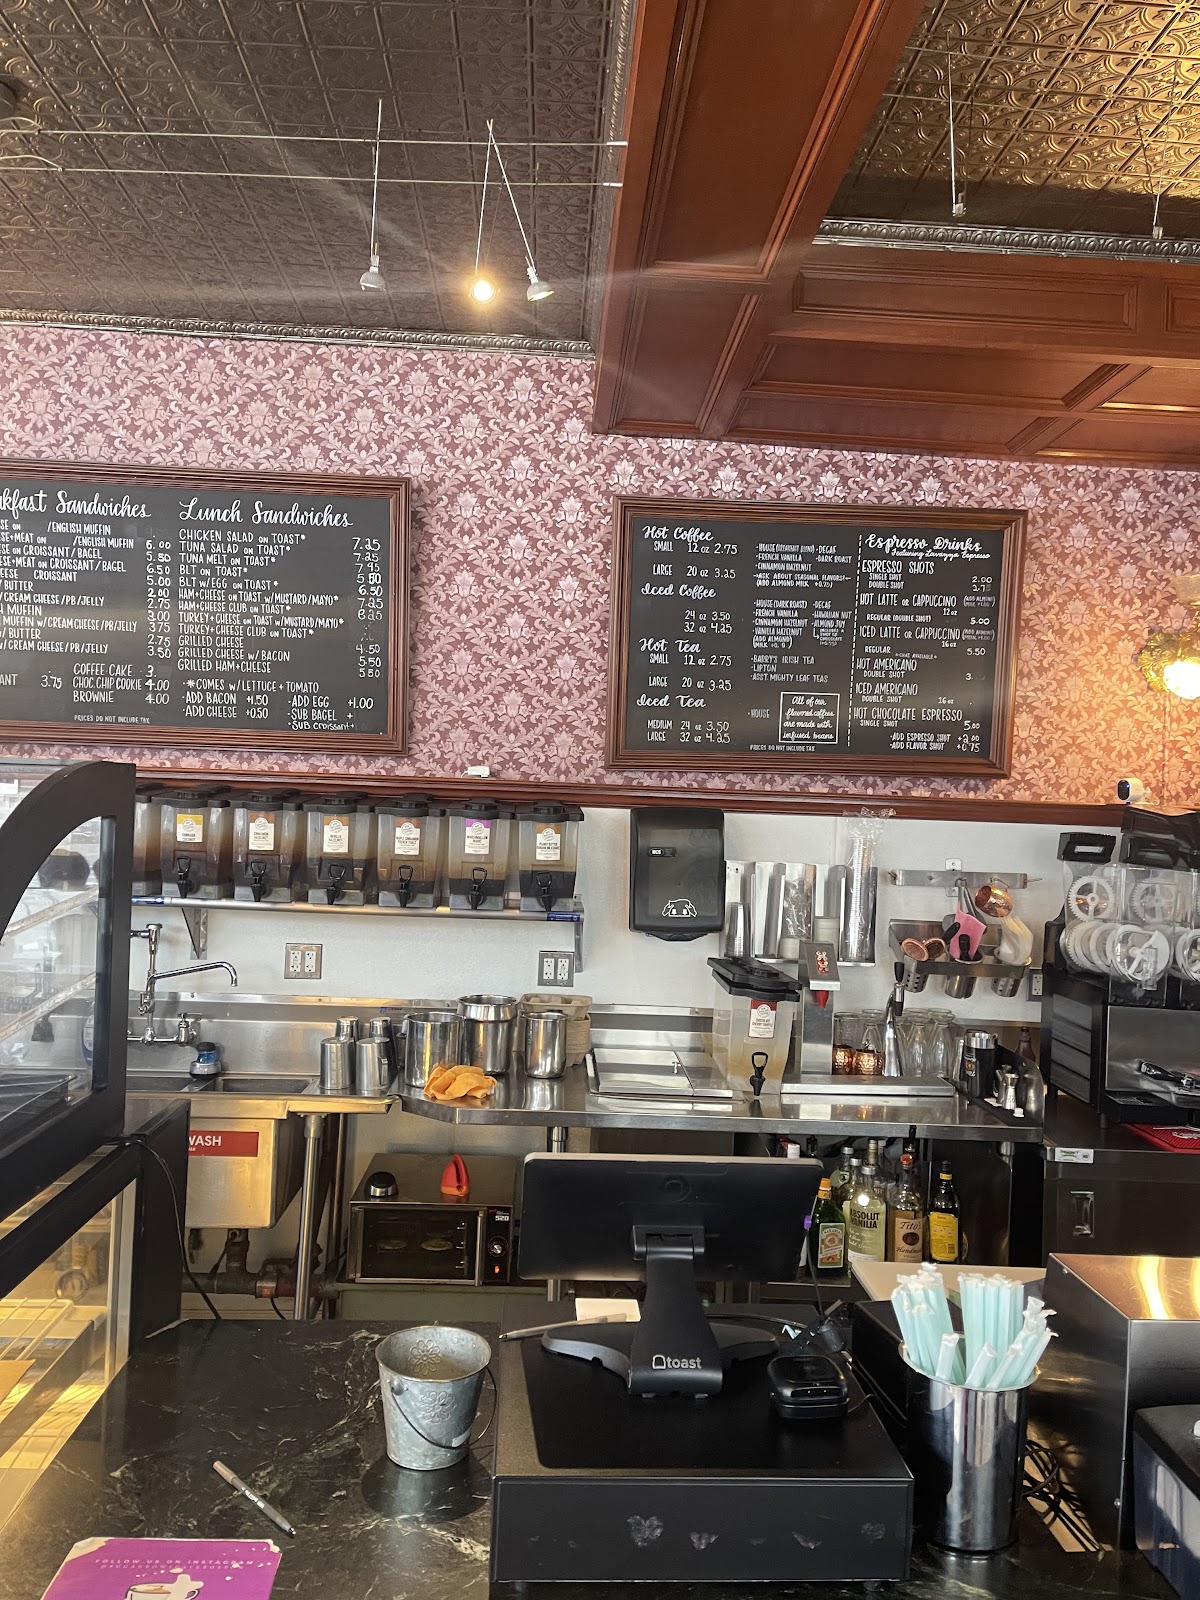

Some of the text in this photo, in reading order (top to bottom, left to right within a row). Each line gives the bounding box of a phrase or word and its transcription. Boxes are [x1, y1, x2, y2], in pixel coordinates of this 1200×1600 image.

[55, 490, 152, 518] Sandwiches
[179, 497, 354, 528] Lunch Sandwiches
[84, 524, 111, 535] MUFFIN
[642, 525, 714, 542] Hot Coffee
[107, 537, 134, 549] MUFFIN
[179, 528, 380, 550] CHICKEN SALAD 7.25
[865, 533, 982, 554] Espresso Drinks
[180, 541, 239, 554] TUNA SALAD
[654, 541, 674, 551] SMALL
[688, 542, 699, 553] 12
[714, 543, 738, 554] 2.75
[179, 553, 227, 565] TUNA MELT
[780, 554, 802, 562] VANILLA
[961, 551, 991, 561] Espresso
[180, 565, 197, 575] BLT
[652, 564, 736, 579] LARGE 20 oz 3.25
[861, 560, 935, 575] ESPRESSO SHOTS
[34, 570, 77, 582] CROISSANT
[4, 580, 33, 591] BUTTER
[179, 577, 196, 588] BLT
[868, 581, 904, 589] DOUBLE SHOT
[178, 589, 261, 602] HAM+CHEESE TOAST
[641, 583, 717, 600] Iced Coffee
[860, 593, 874, 606] HOT
[878, 593, 898, 606] LATTE
[912, 594, 957, 607] CAPPUCCINO
[7, 604, 42, 616] MUFFIN
[178, 601, 247, 613] HAM+CHEESE CLUB
[943, 608, 950, 616] 12
[253, 615, 273, 626] TOAST
[685, 610, 731, 621] 24 3.50
[776, 610, 852, 619] VANILLA NUT
[867, 613, 990, 625] REGULAR 5.00
[3, 615, 34, 627] MUFFIN
[814, 620, 846, 628] ALMOND JOY
[9, 628, 41, 640] BUTTER
[247, 626, 266, 637] CLUB
[684, 622, 732, 634] 32 4.25
[860, 625, 876, 638] ICED
[880, 626, 900, 639] LATTE
[915, 627, 960, 640] CAPPUCCINO
[178, 636, 244, 648] GRILLED CHEESE
[639, 638, 701, 653] Hot Tea
[147, 646, 171, 658] 3.50
[178, 647, 244, 660] GRILLED CHEESE
[865, 646, 891, 654] REGULAR
[177, 659, 212, 671] GRILLED
[650, 653, 732, 667] SMALL 12 2.75
[782, 655, 815, 664] IRISH TEA
[856, 658, 917, 671] HOT AMERICANO
[73, 663, 133, 676] COFFEE CAKE
[753, 664, 777, 672] LIPTON
[863, 670, 886, 678] DOUBLE
[116, 679, 142, 691] COOKIE
[649, 676, 731, 691] LARGE 20 3.25
[813, 675, 828, 683] TEAS
[286, 681, 319, 693] TOMATO
[855, 682, 918, 695] ICED AMERICANO
[73, 690, 114, 703] BROWNIE
[206, 693, 236, 705] BACON
[313, 696, 373, 709] EGG +1.00
[636, 694, 706, 708] Iced Tea
[861, 695, 902, 703] DOUBLE SHOT
[207, 707, 237, 718] CHEESE
[311, 710, 337, 721] BAGEL
[751, 709, 770, 719] HOUSE
[785, 708, 836, 720] flavored coffees
[853, 707, 963, 721] HOT CHOCOLATE ESPRESSO
[117, 716, 139, 724] INCLUDE
[647, 720, 690, 730] MEDIUM 24
[796, 720, 833, 729] made with
[647, 731, 691, 742] LARGE 32
[782, 731, 834, 742] infused beans
[907, 733, 951, 742] ESPRESSO SHOT
[906, 742, 945, 751] FLAVOR SHOT
[665, 1357, 702, 1369] toast
